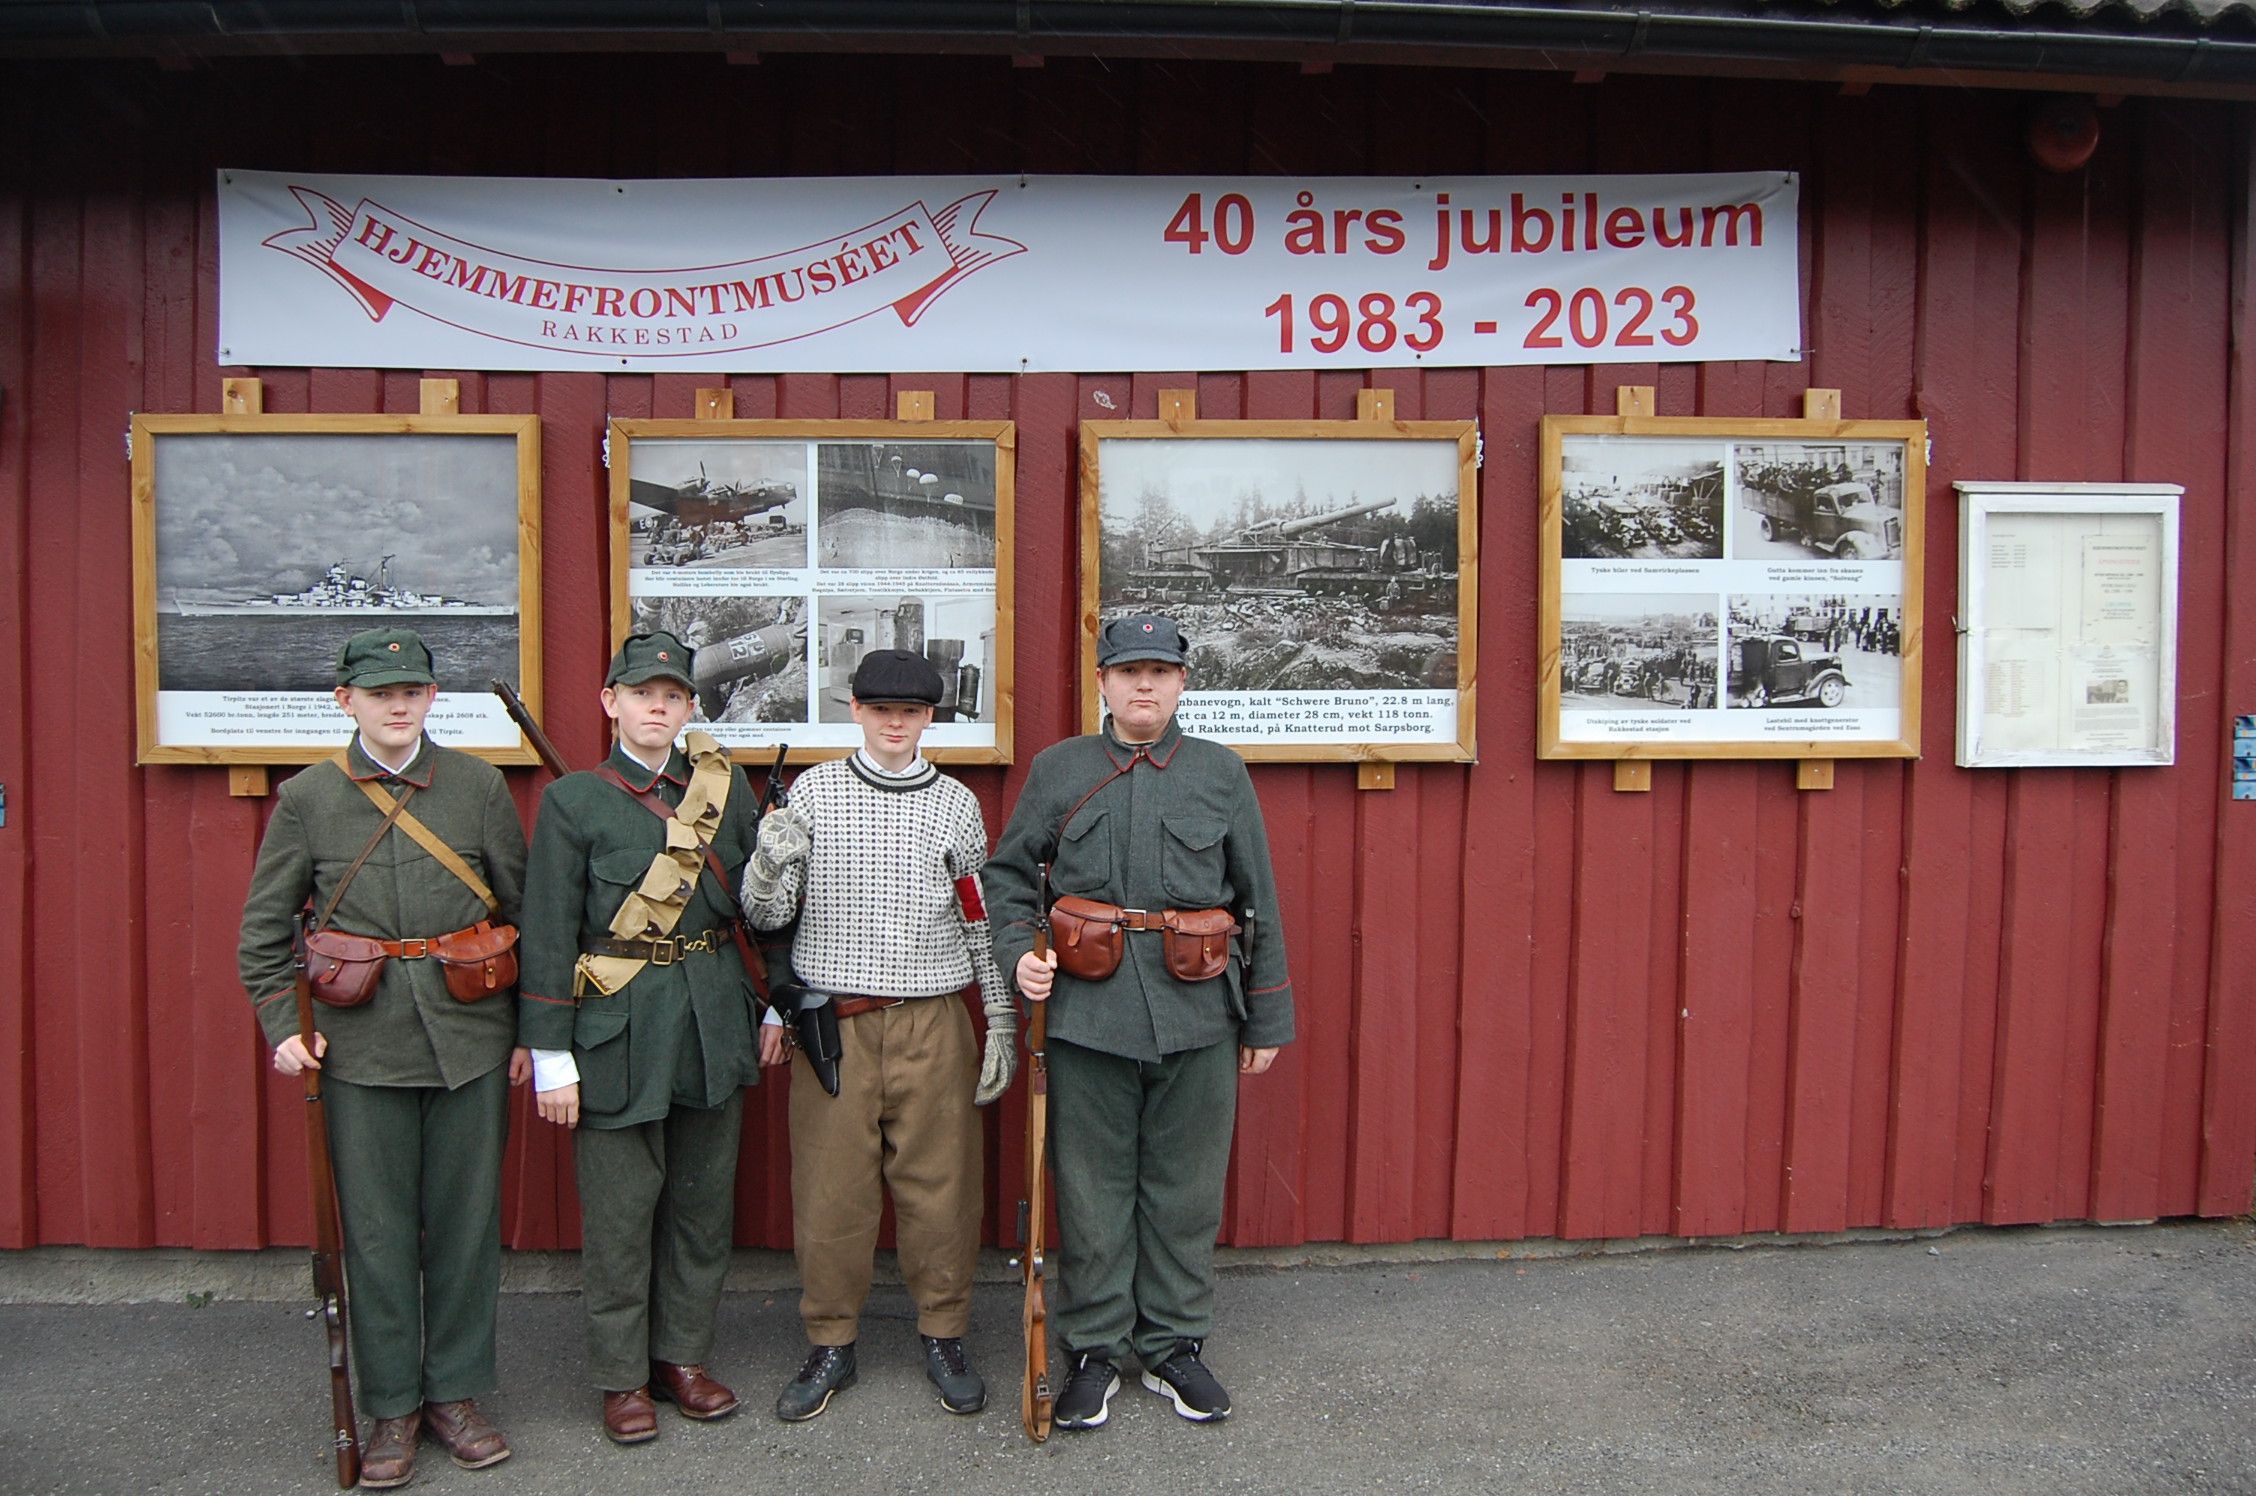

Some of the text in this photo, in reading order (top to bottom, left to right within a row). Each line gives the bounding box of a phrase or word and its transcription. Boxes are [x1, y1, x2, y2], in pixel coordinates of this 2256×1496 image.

[1165, 193, 1761, 271] 40 års jubileum
[354, 215, 924, 318] HJEMMEFRONTMUSÉET
[1265, 286, 1699, 353] 1983 - 2023
[541, 320, 738, 344] RAKKESTAD
[1178, 697, 1246, 710] nbanevogn,
[1248, 697, 1273, 706] kalt
[1381, 696, 1409, 705] 22.8
[1426, 696, 1457, 707] lang,
[1212, 710, 1226, 720] 12
[1230, 713, 1245, 721] m,
[1248, 710, 1301, 719] diameter
[1304, 710, 1320, 719] 28
[1322, 712, 1344, 720] cm,
[1348, 710, 1374, 719] vekt
[1378, 709, 1400, 719] 118
[1181, 723, 1435, 735] ed Rakkestad, på Knatterud mot Sarpsborg.
